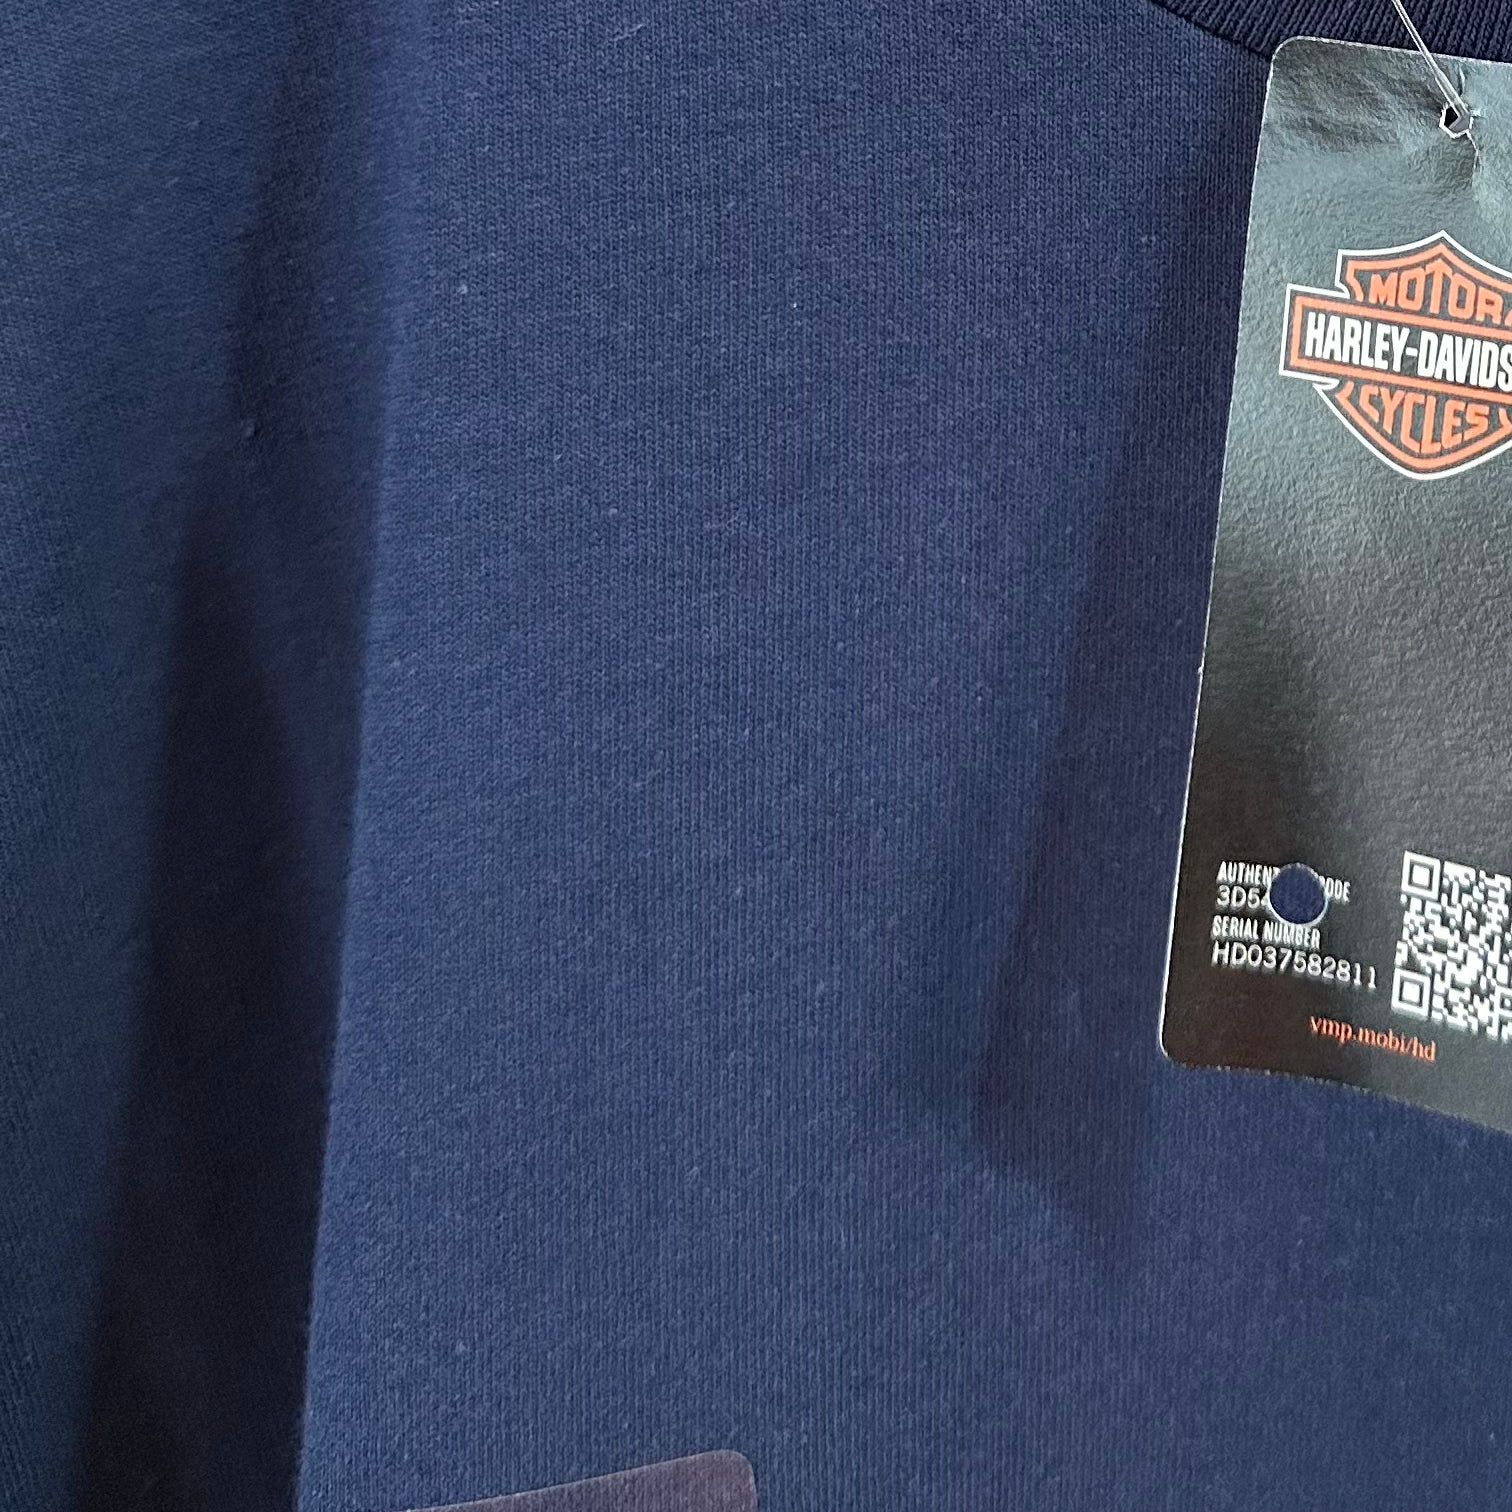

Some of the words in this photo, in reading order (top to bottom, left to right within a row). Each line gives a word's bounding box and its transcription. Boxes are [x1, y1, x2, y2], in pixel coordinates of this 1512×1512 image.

[1368, 258, 1504, 326] MOTOR
[1359, 384, 1490, 454] CYCLES
[1216, 884, 1270, 909] 3D5
[1212, 914, 1259, 940] SERIAL
[1262, 920, 1321, 950] NUMBER
[1212, 940, 1377, 989] HD037582811
[1308, 1014, 1437, 1064] vmp.mobi/hd
